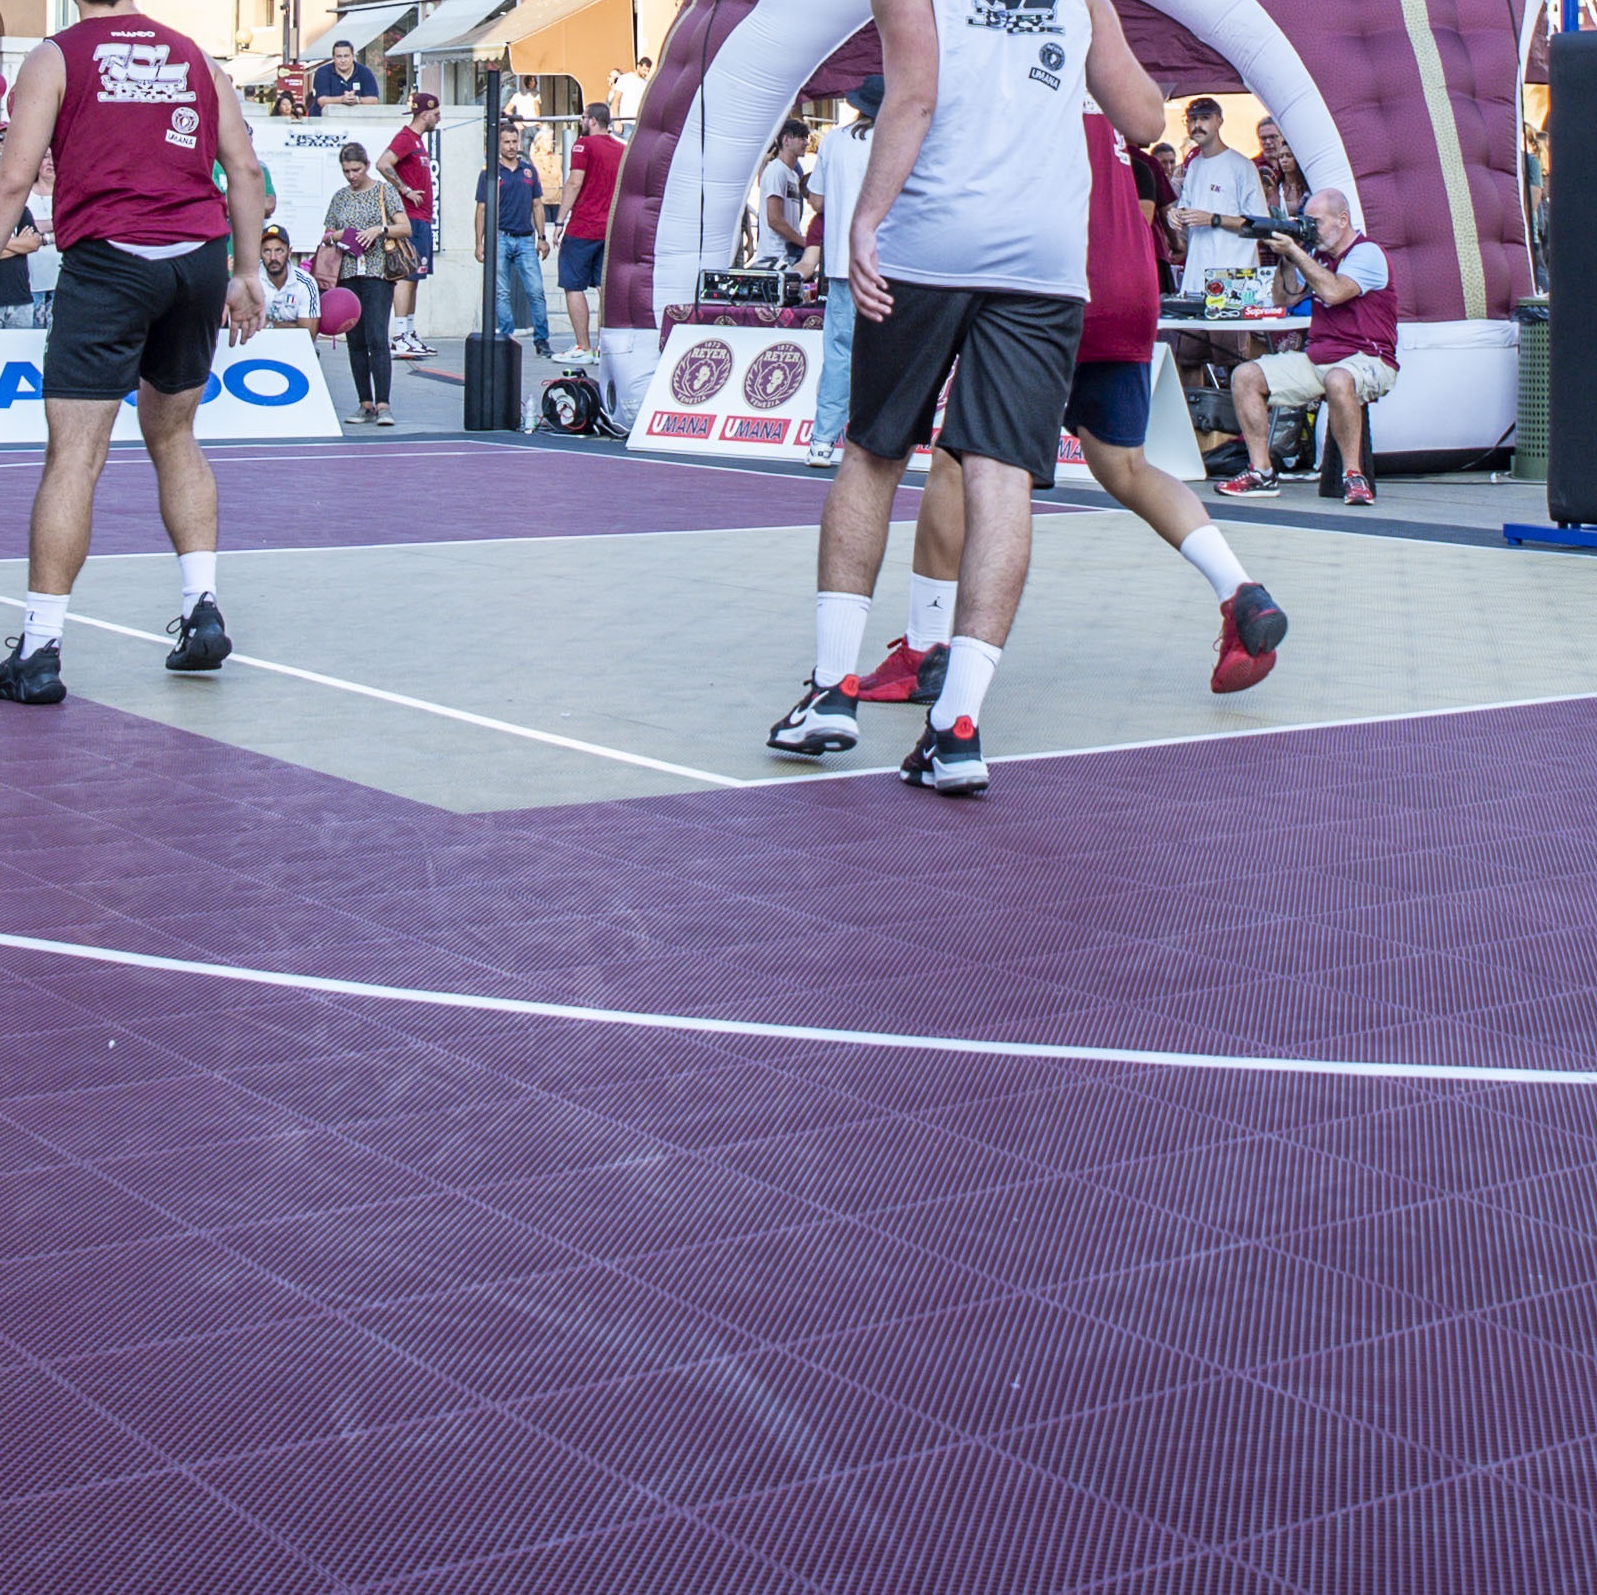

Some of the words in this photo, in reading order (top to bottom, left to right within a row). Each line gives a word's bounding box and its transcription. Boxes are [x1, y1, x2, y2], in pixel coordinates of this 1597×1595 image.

[1032, 68, 1060, 88] UMANA
[690, 347, 728, 360] REYER
[763, 350, 801, 363] REYER
[677, 393, 708, 405] VENEZIA
[652, 413, 710, 435] UMANA
[724, 417, 785, 440] UMANA
